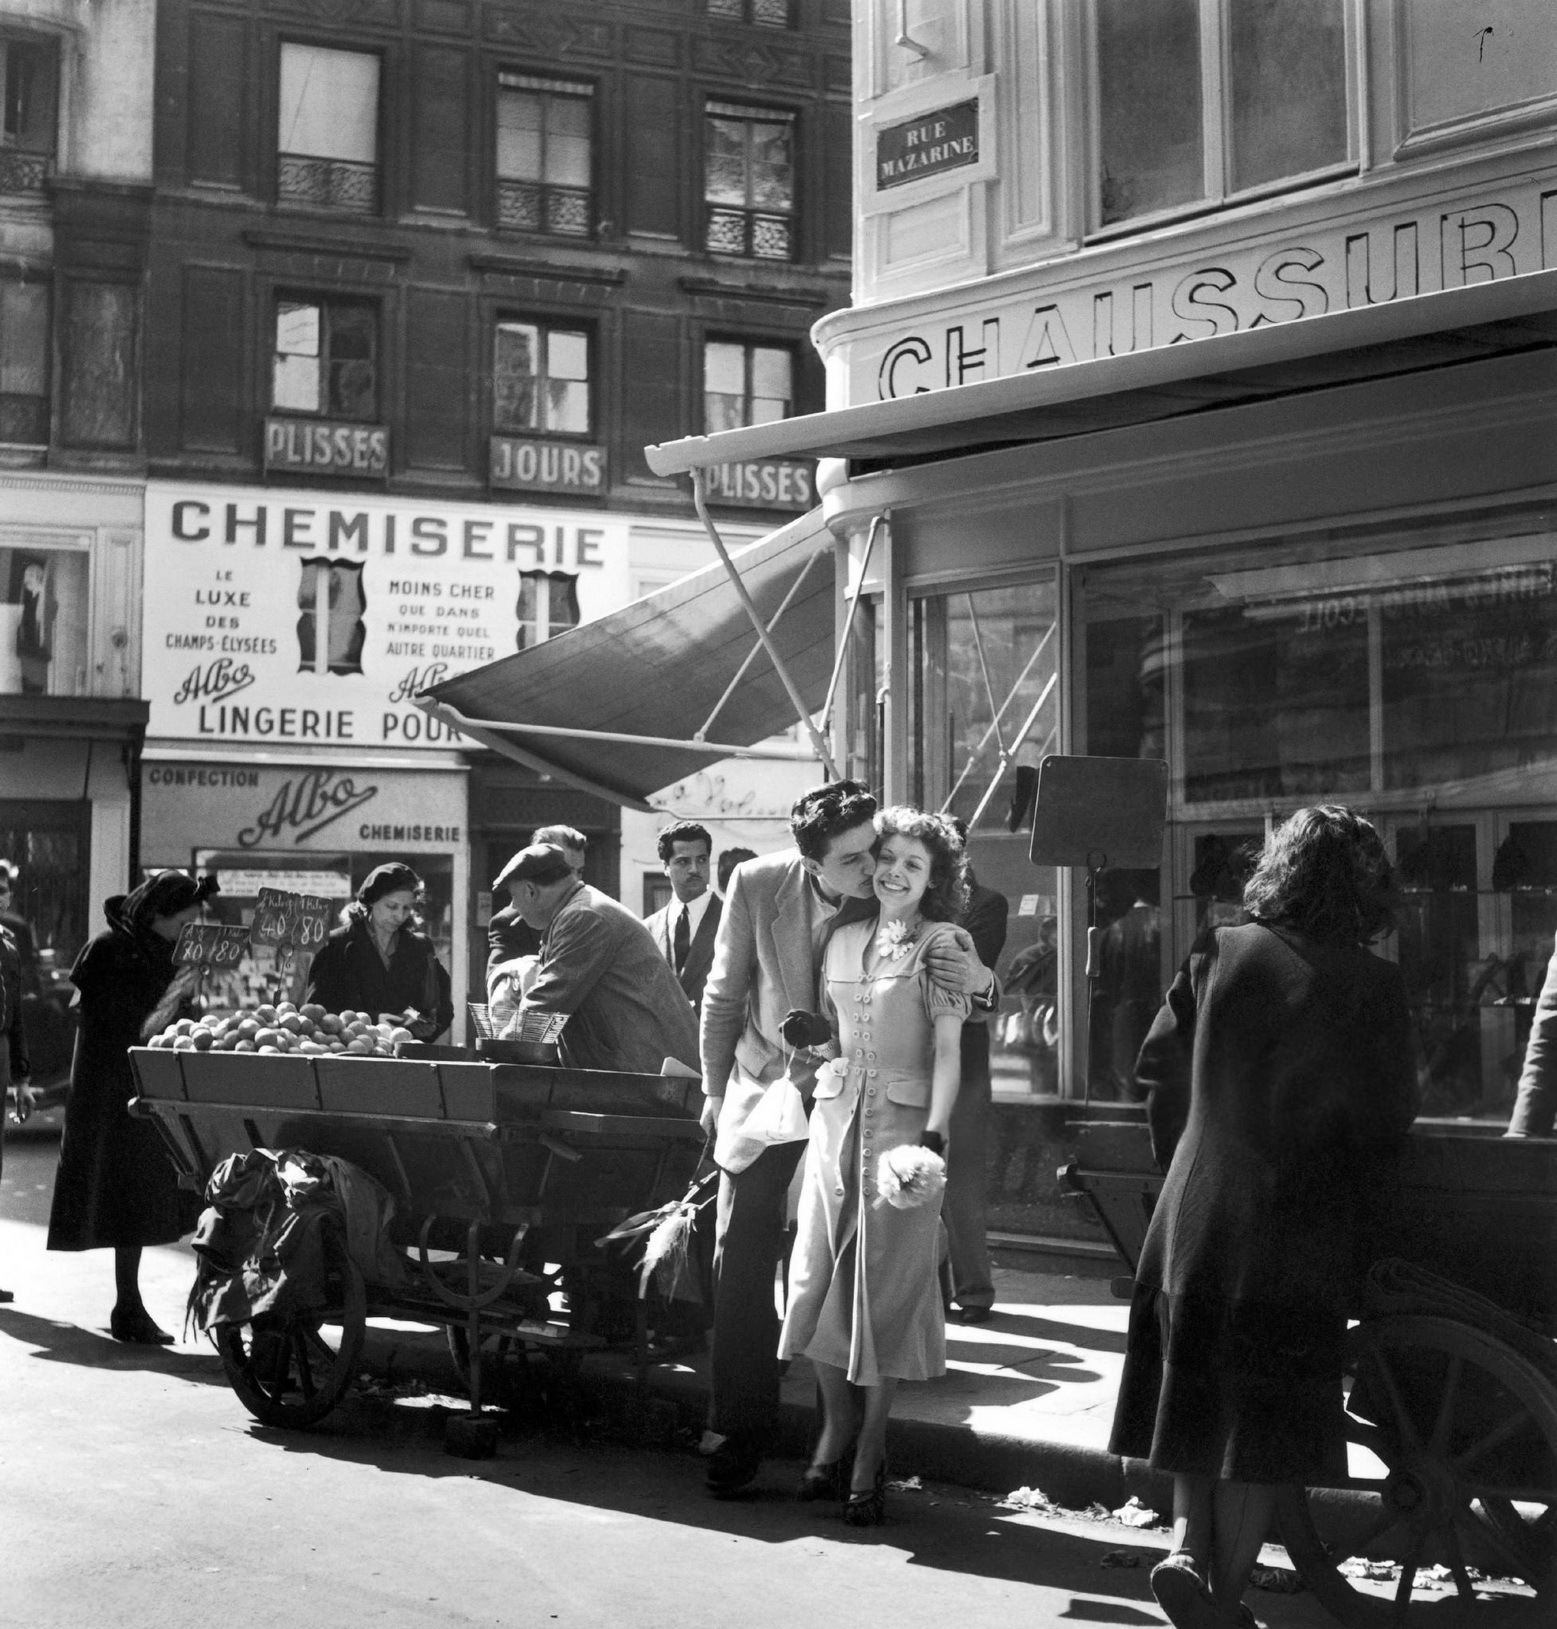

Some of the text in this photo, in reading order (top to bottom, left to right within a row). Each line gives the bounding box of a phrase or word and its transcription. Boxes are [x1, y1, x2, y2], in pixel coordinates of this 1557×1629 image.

[907, 121, 946, 147] RUE
[881, 136, 974, 178] MAZARINE
[494, 443, 600, 486] JOURS
[172, 500, 605, 567] CHEMISERIE
[216, 570, 233, 581] LE
[195, 589, 251, 606] LUXE
[389, 580, 494, 600] MOINS CHER
[205, 615, 240, 629] DES
[399, 604, 480, 619] QUE DANS
[457, 626, 490, 639] QUEL
[386, 642, 495, 661] AUTRE QUARTIER
[173, 657, 256, 704] Albo
[200, 704, 353, 739] LINGERIE
[149, 768, 259, 786] CONFECTION
[238, 768, 378, 848] Albo
[359, 823, 461, 843] CHEMISERIE
[261, 914, 286, 938] 40
[300, 916, 325, 945] 80
[215, 940, 241, 962] 80
